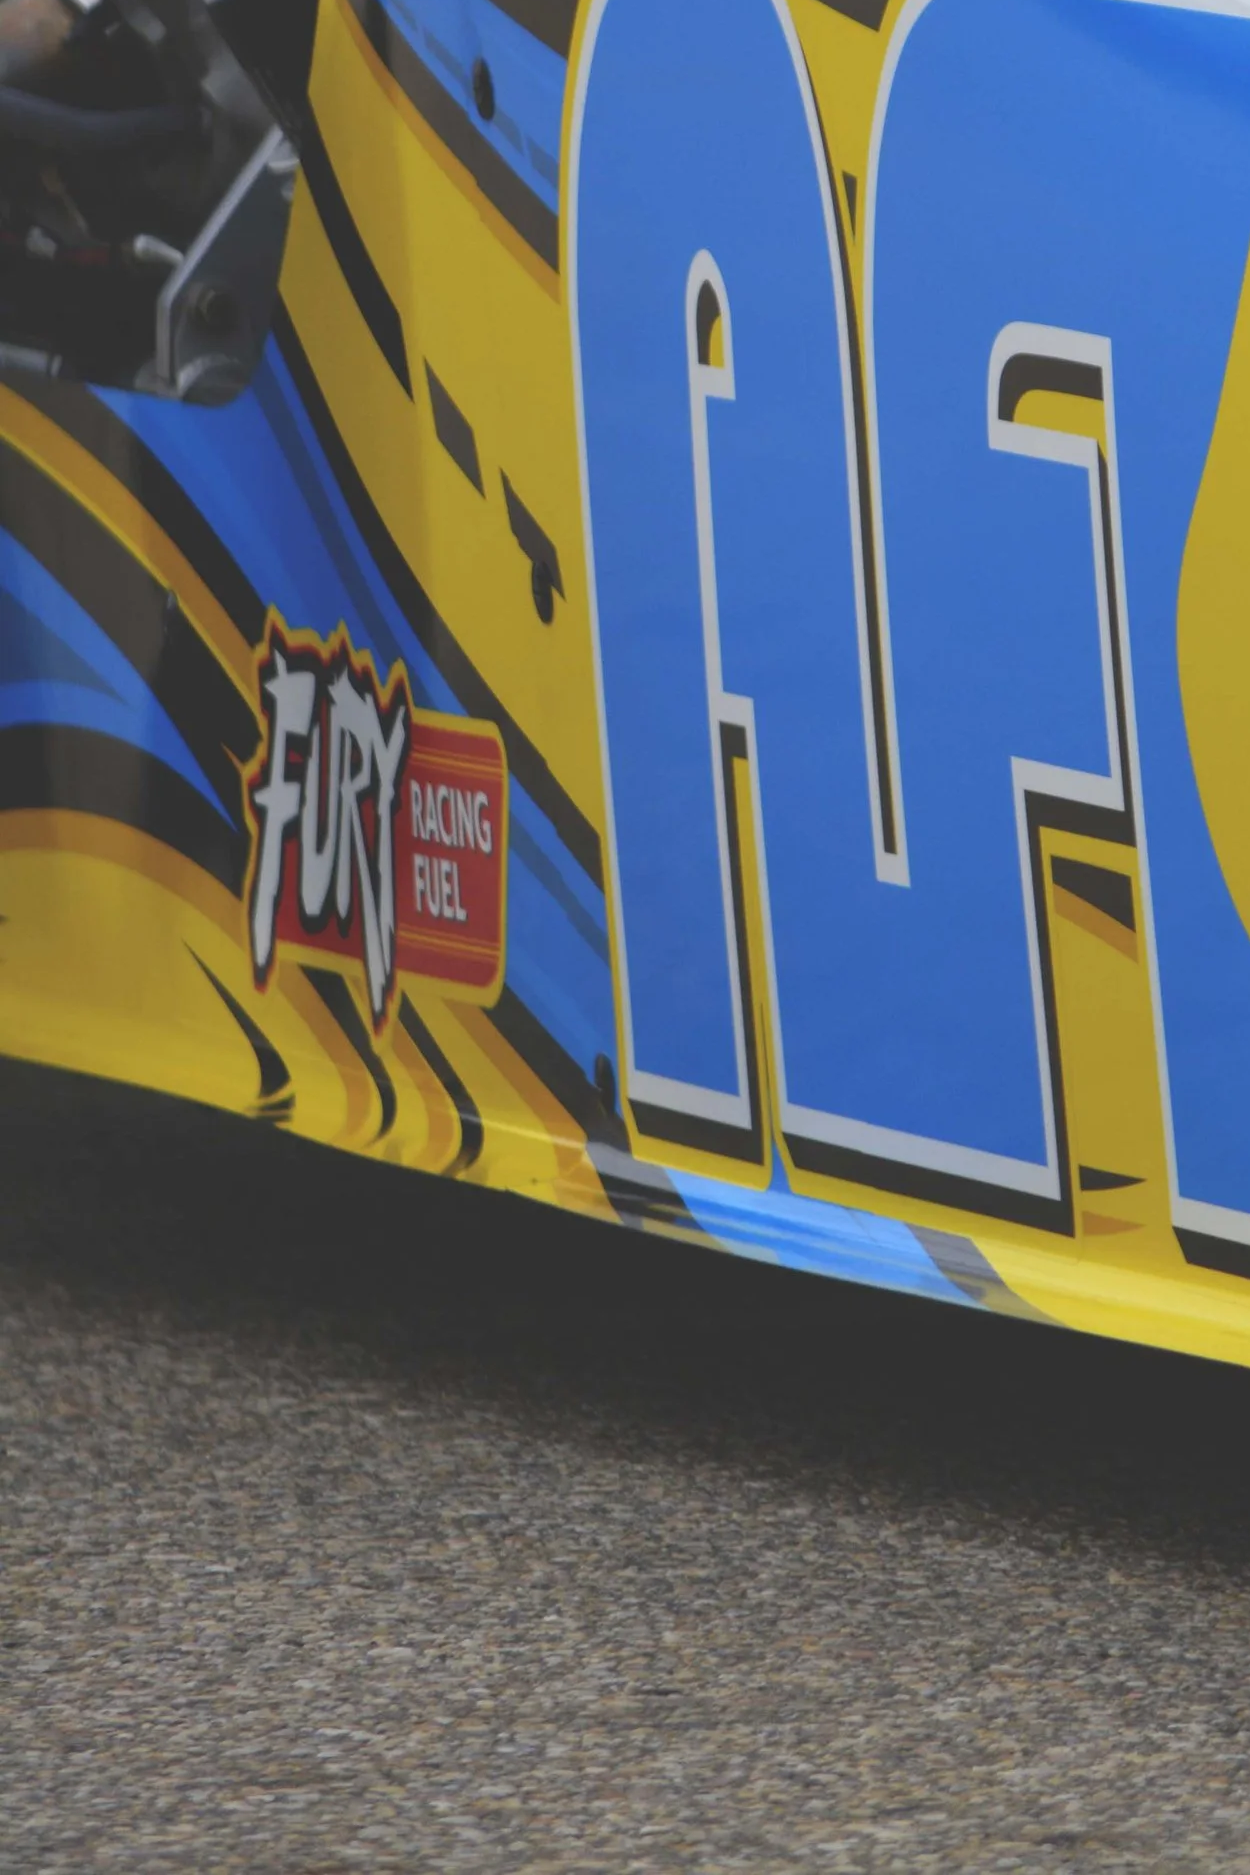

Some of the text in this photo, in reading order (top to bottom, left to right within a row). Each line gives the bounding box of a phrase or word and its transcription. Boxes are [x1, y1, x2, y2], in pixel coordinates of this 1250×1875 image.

[251, 648, 406, 1013] FURY
[410, 779, 492, 855] RACING
[413, 858, 468, 922] FUEL
